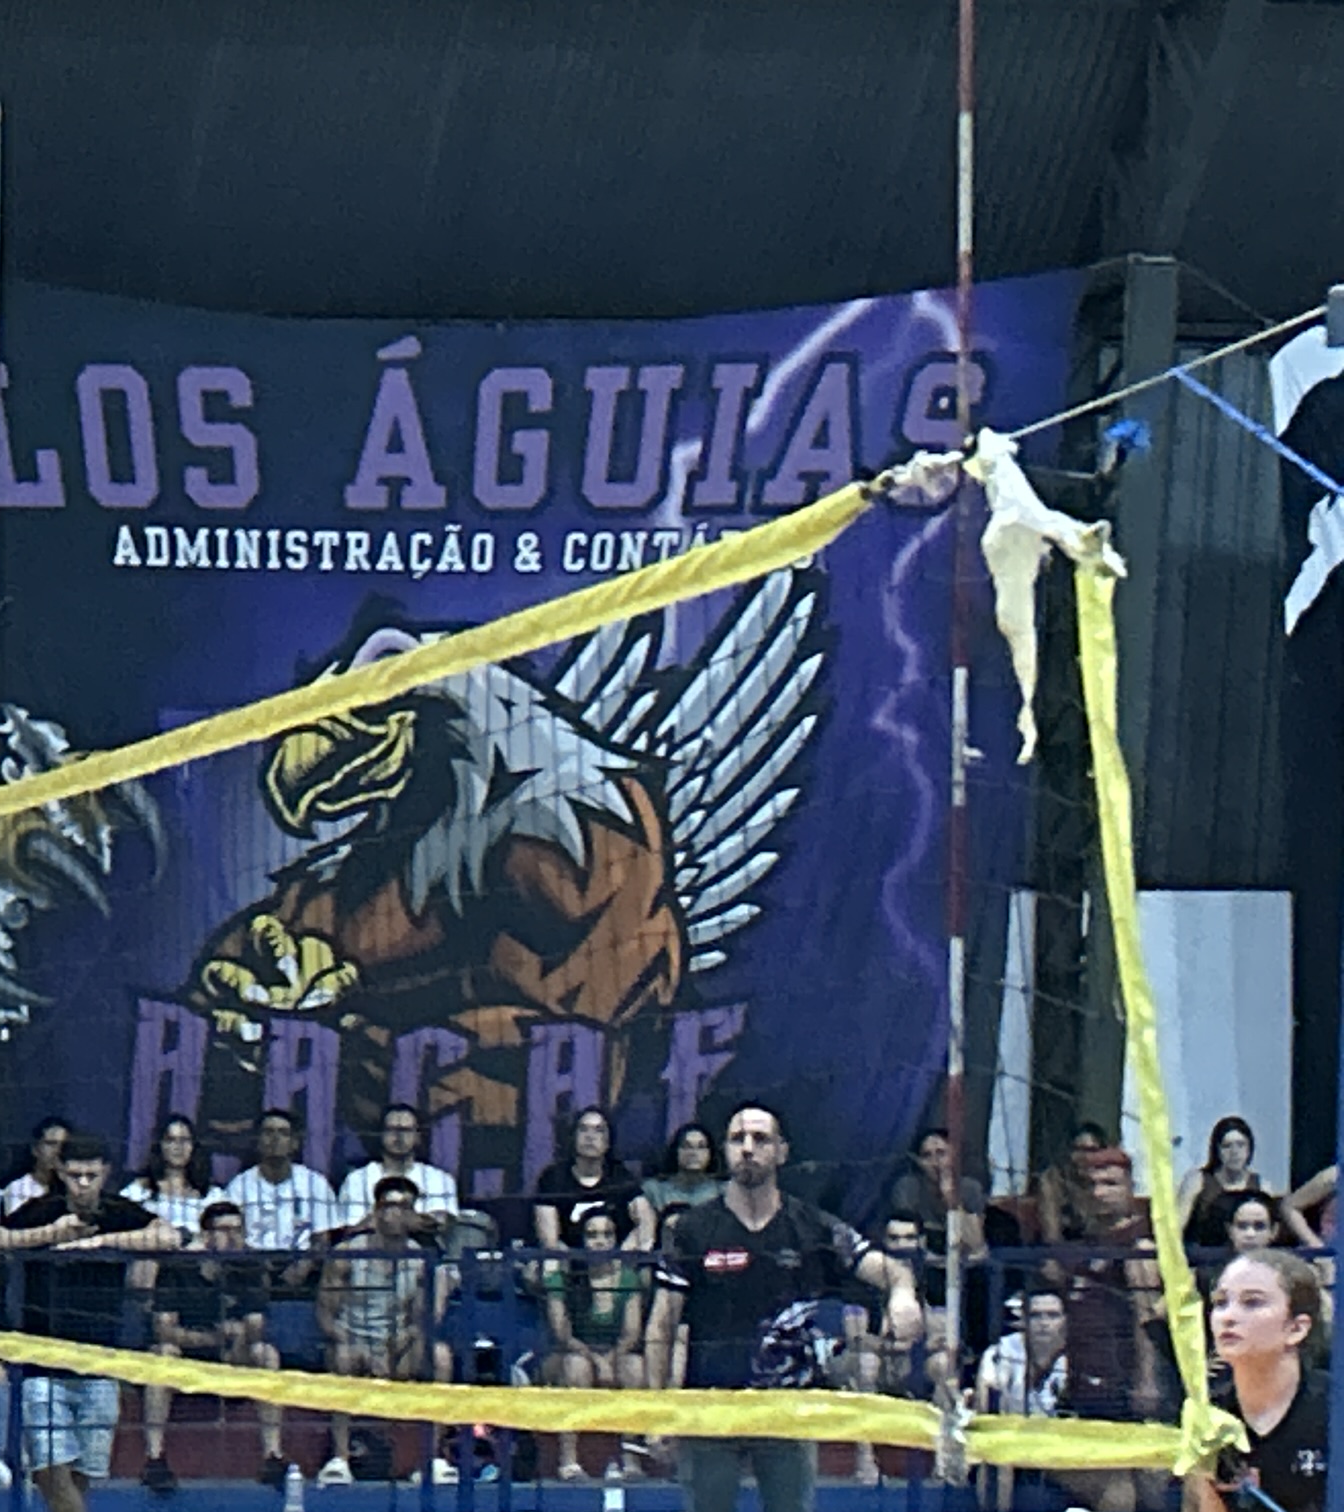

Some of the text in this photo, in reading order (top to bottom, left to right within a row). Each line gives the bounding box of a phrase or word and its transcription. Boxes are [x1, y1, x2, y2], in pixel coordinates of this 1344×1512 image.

[343, 334, 987, 510] ÁGUIAS
[112, 524, 494, 578] ADMINISTRAÇÃO
[513, 531, 542, 573] &
